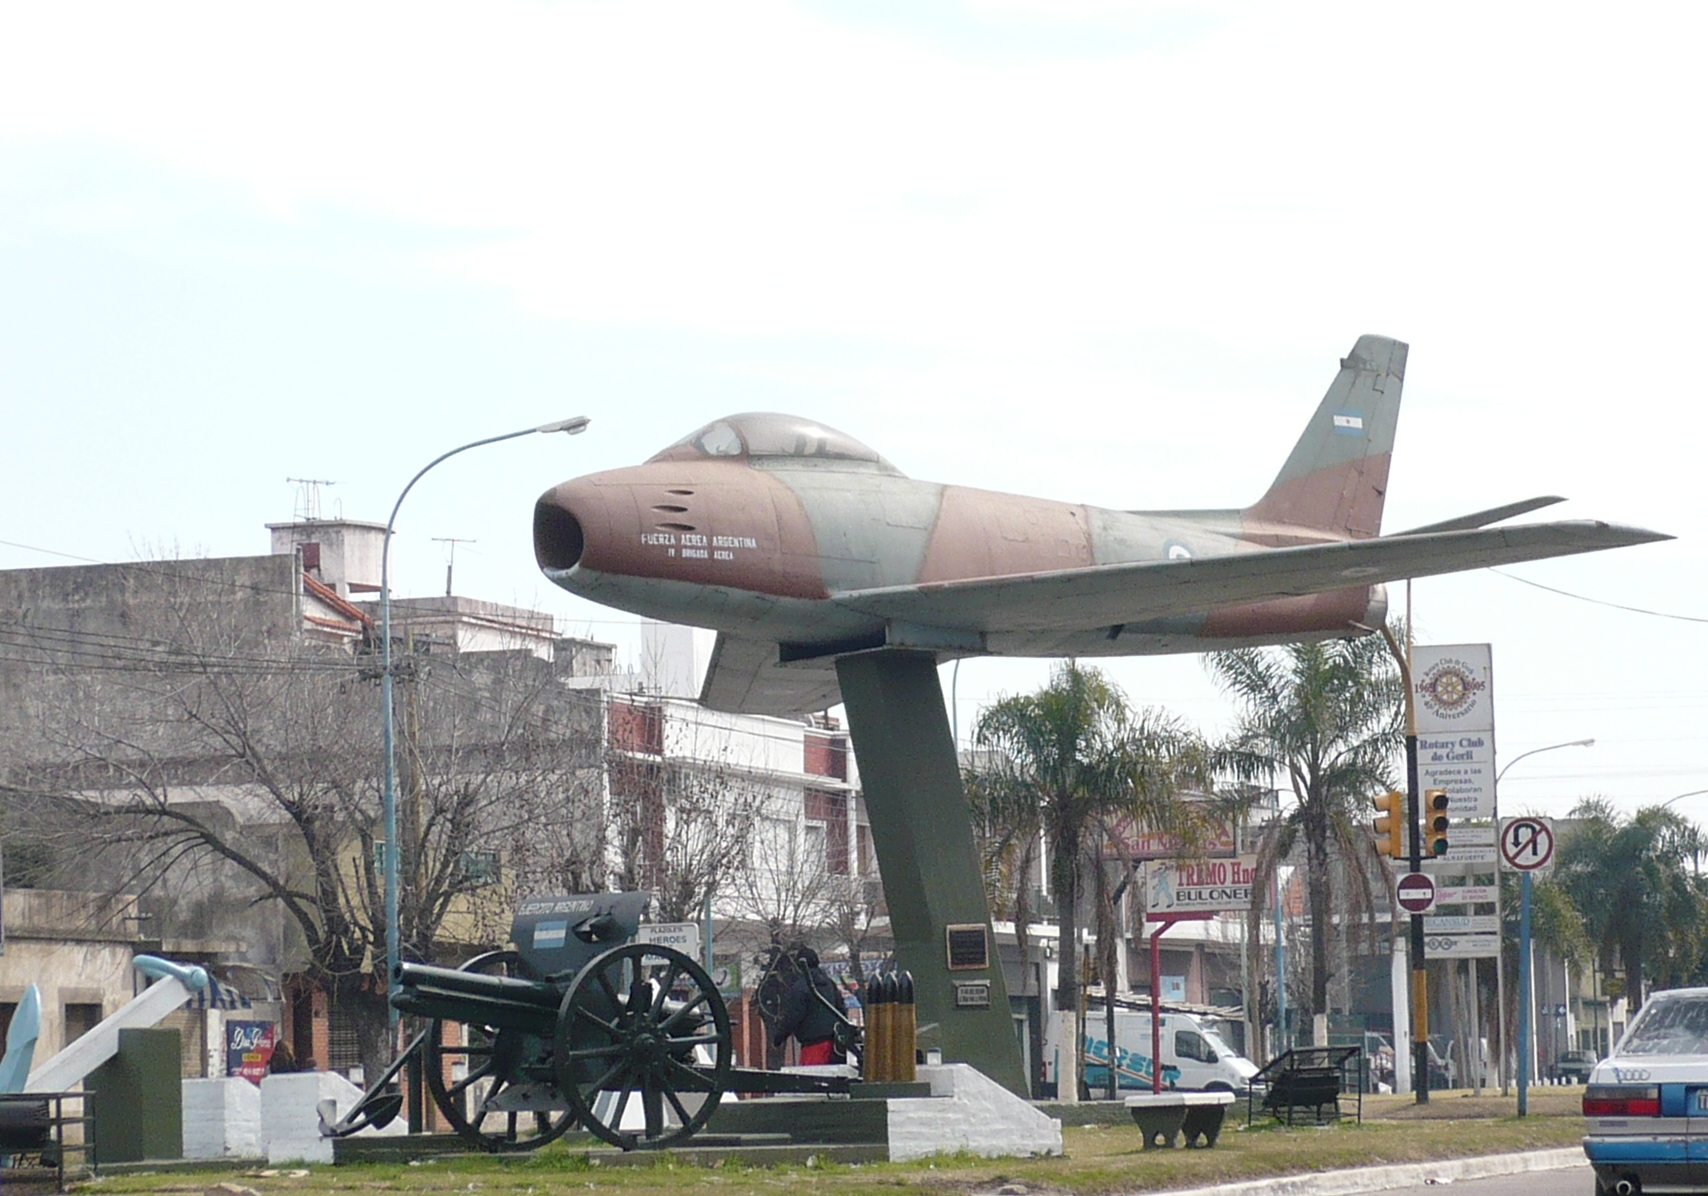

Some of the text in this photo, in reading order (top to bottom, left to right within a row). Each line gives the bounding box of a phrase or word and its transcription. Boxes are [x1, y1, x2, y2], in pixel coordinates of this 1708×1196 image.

[641, 533, 758, 548] FUERZA AEREA ARGENTINA
[681, 548, 709, 558] BRIGADA
[713, 550, 734, 560] AEREA
[1419, 737, 1485, 752] Rotary Club
[1431, 750, 1473, 762] de Gerli
[1424, 768, 1461, 777] Agradece
[1470, 767, 1482, 775] las
[1177, 863, 1227, 887] TREMO
[649, 935, 688, 944] HEROES
